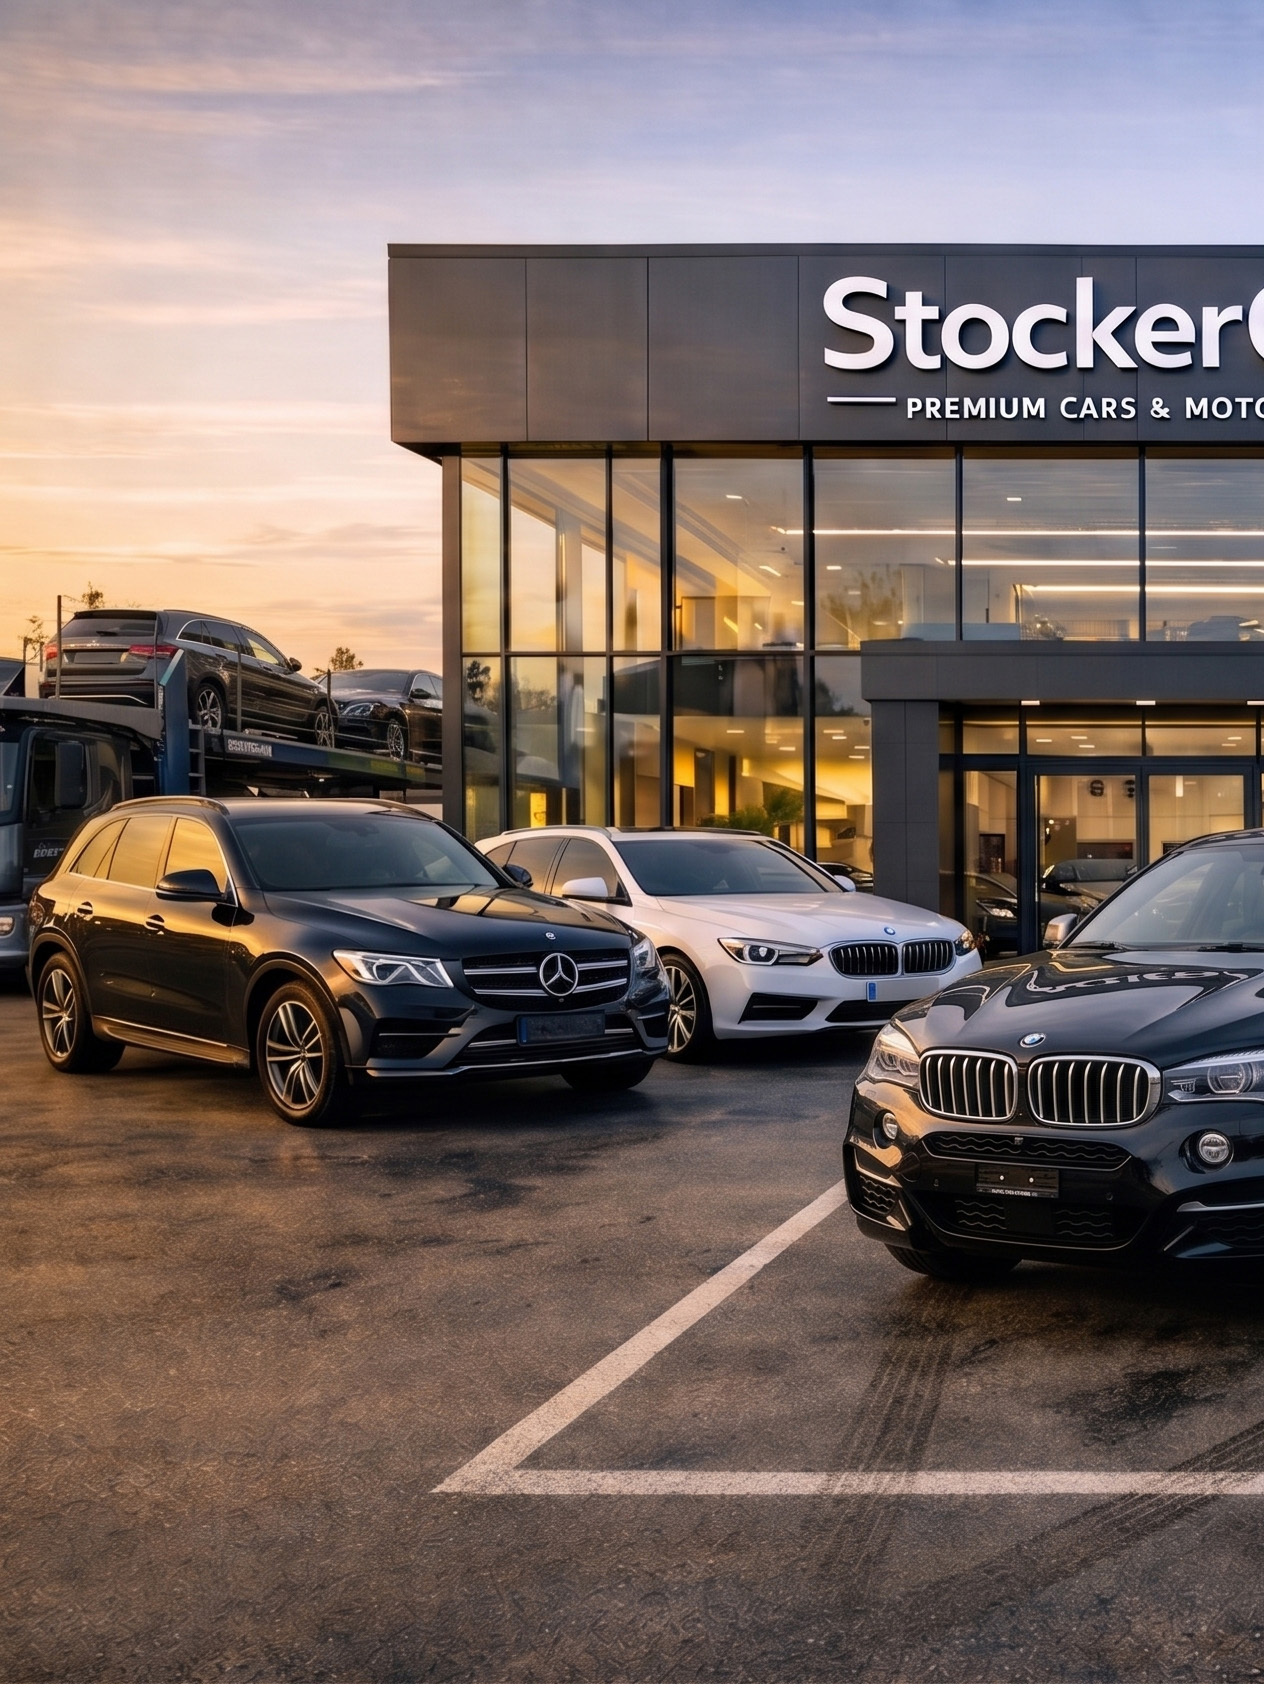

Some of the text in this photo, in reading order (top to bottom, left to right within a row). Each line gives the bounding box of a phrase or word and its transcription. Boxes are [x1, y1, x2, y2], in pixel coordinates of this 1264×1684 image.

[907, 397, 1046, 419] PREMIUM
[1060, 397, 1136, 419] CARS
[1150, 397, 1171, 419] &
